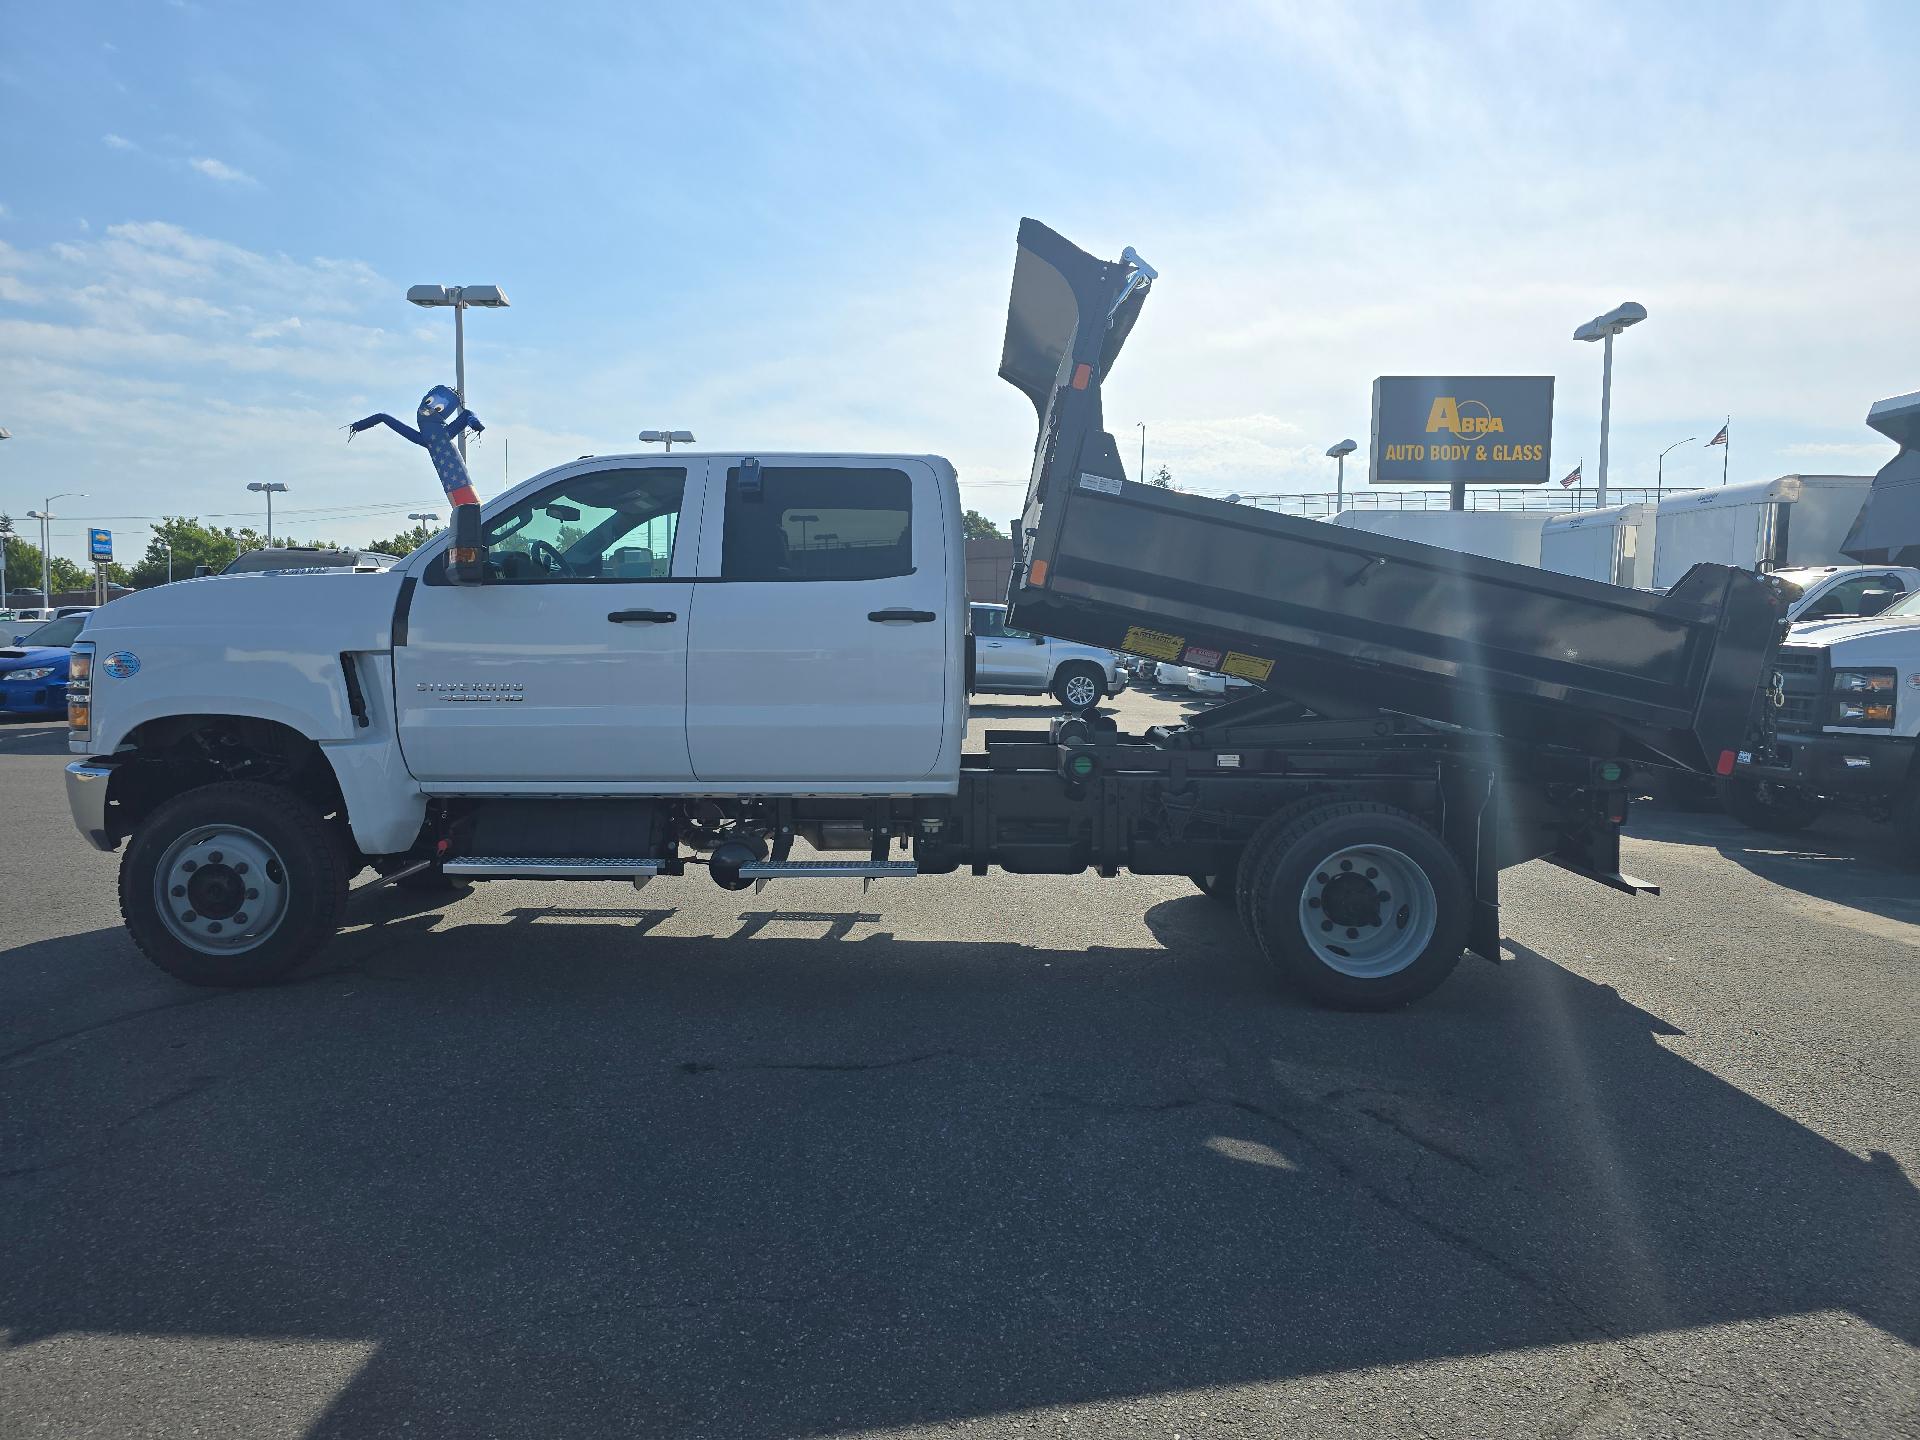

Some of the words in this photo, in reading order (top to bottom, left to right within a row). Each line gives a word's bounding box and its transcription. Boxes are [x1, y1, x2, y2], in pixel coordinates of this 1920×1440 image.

[1425, 397, 1504, 433] ABRA
[1385, 444, 1425, 461] AUTO
[1430, 444, 1471, 461] BODY
[1475, 444, 1488, 461] &
[1492, 444, 1543, 461] GLASS
[416, 682, 524, 692] SILVERADO
